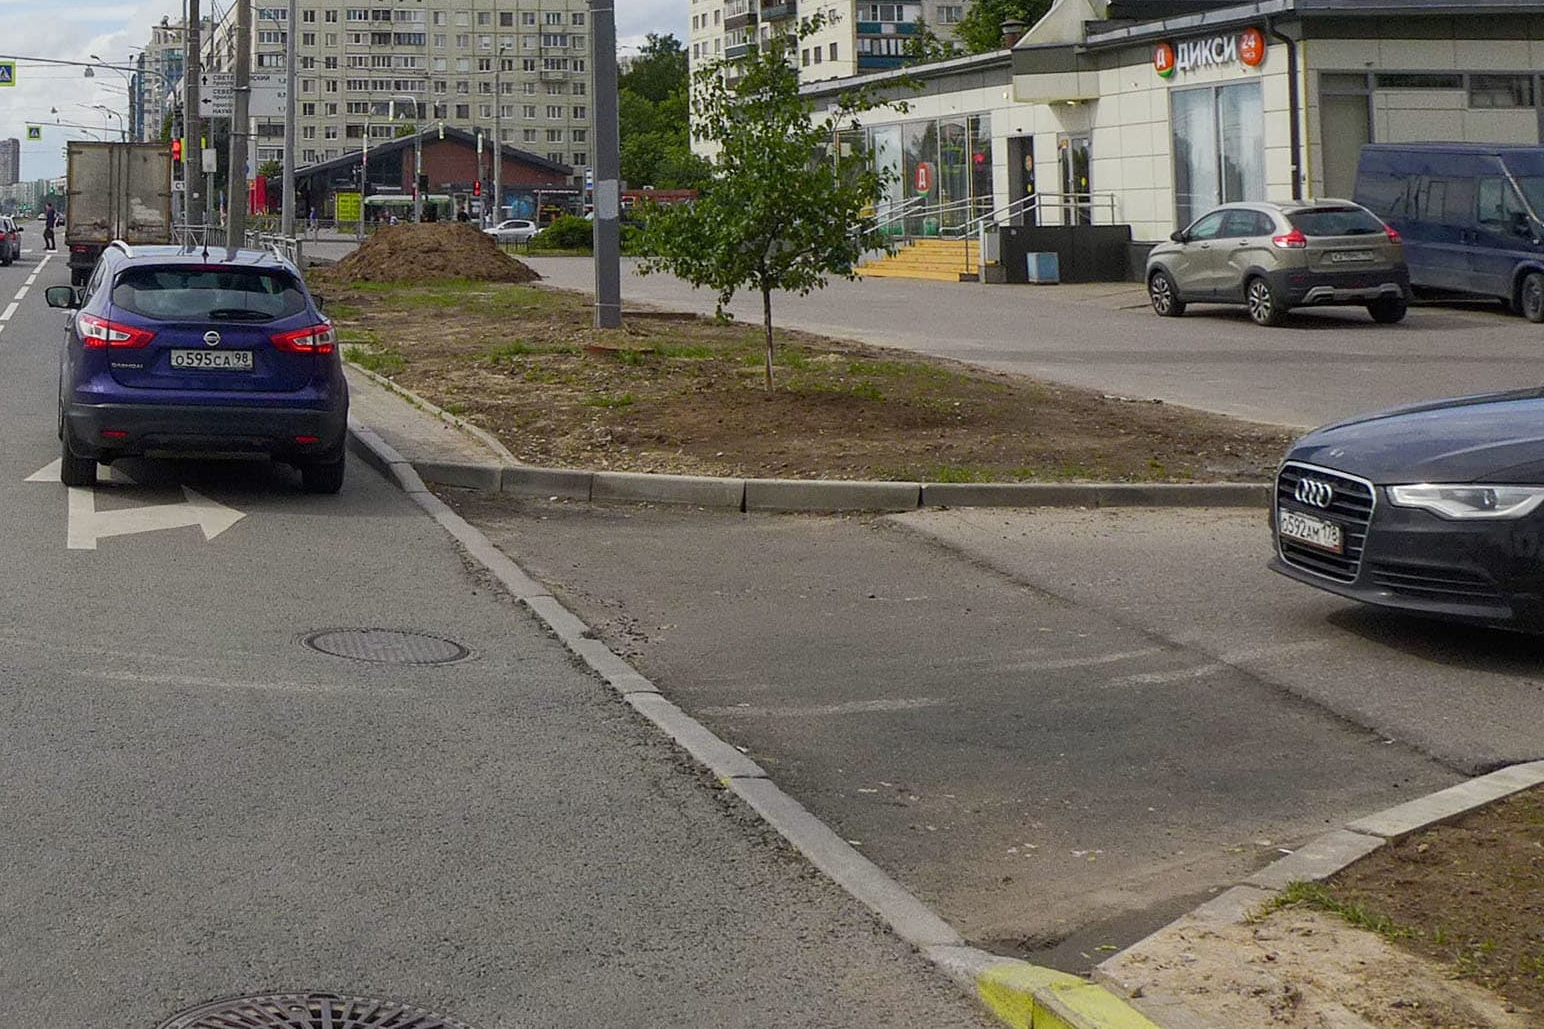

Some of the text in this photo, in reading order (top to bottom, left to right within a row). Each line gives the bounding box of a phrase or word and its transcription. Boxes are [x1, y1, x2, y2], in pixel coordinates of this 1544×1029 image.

[1176, 35, 1237, 70] ДИКСИ
[1241, 34, 1256, 50] 24
[234, 352, 248, 364] 98
